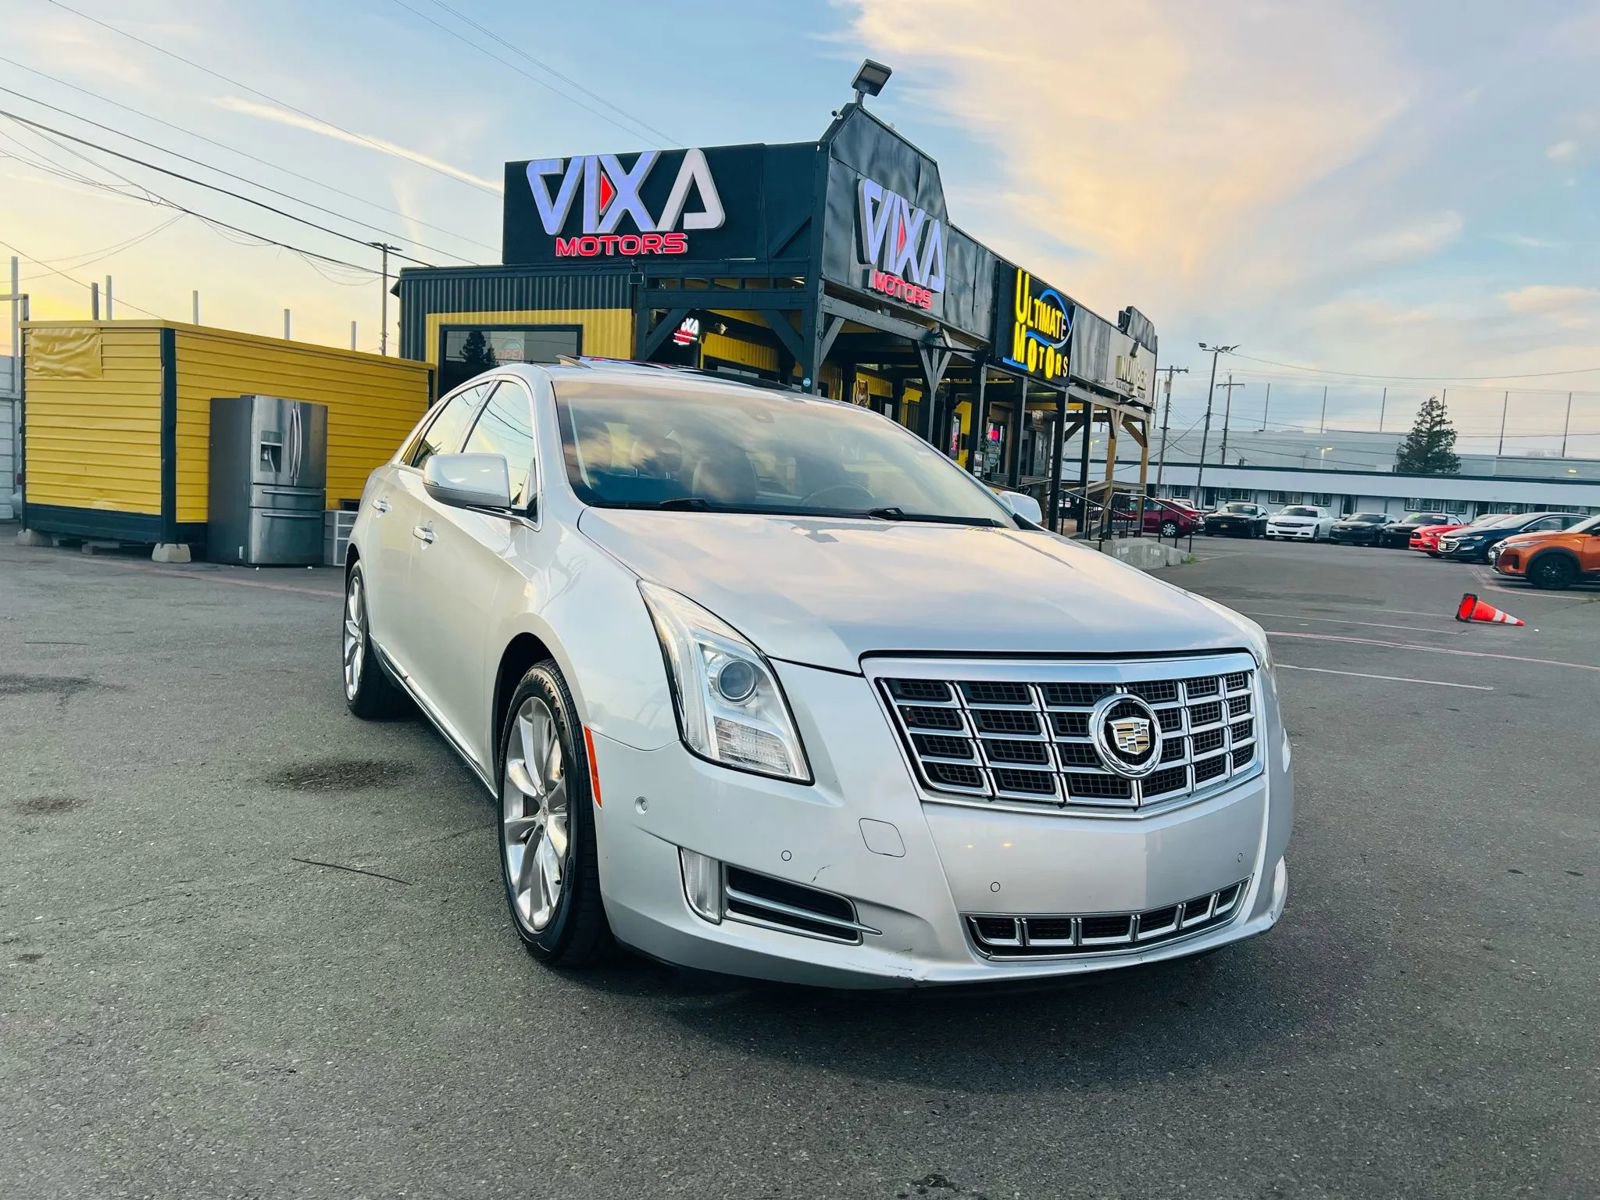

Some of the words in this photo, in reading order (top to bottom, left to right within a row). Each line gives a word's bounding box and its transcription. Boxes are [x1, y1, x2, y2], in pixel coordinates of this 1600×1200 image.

[526, 147, 726, 235] VIXA
[555, 232, 689, 257] MOTORS
[859, 178, 945, 293] VIXA
[871, 268, 932, 310] MOTORS
[1015, 267, 1067, 341] ULTIMATE
[1012, 321, 1069, 379] MOTORS
